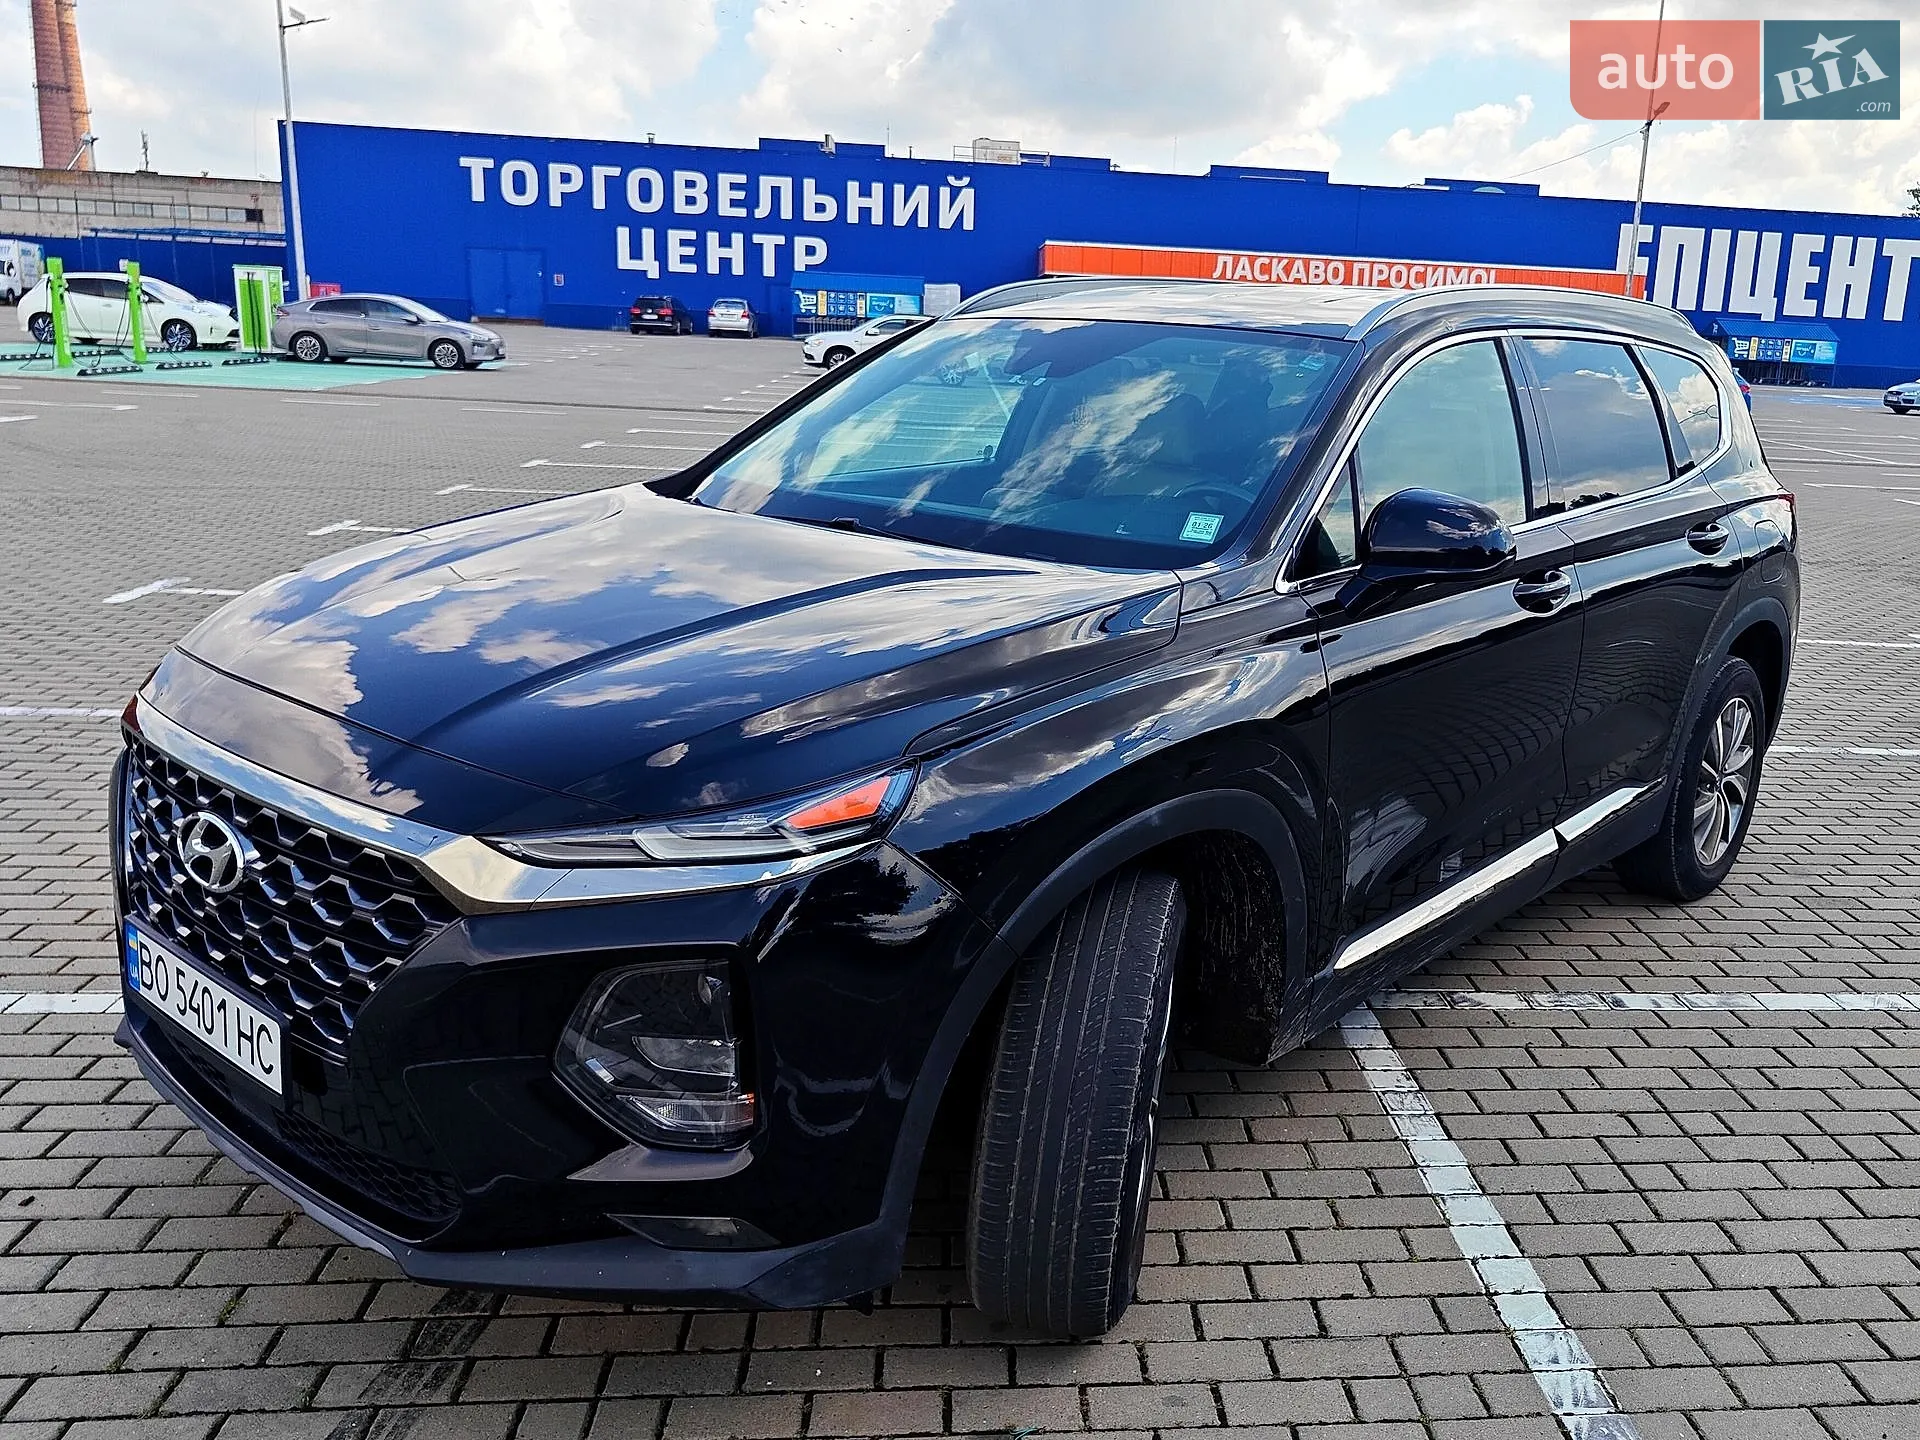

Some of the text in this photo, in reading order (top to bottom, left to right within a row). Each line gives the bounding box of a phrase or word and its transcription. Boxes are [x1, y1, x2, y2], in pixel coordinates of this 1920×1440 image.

[459, 156, 977, 231] ТОРГОВЕЛЬНИЙ
[615, 226, 829, 280] ЦЕНТР
[1212, 254, 1346, 285] ЛАСКАВО
[130, 964, 139, 981] UA
[138, 940, 274, 1075] BO 5401 HC
